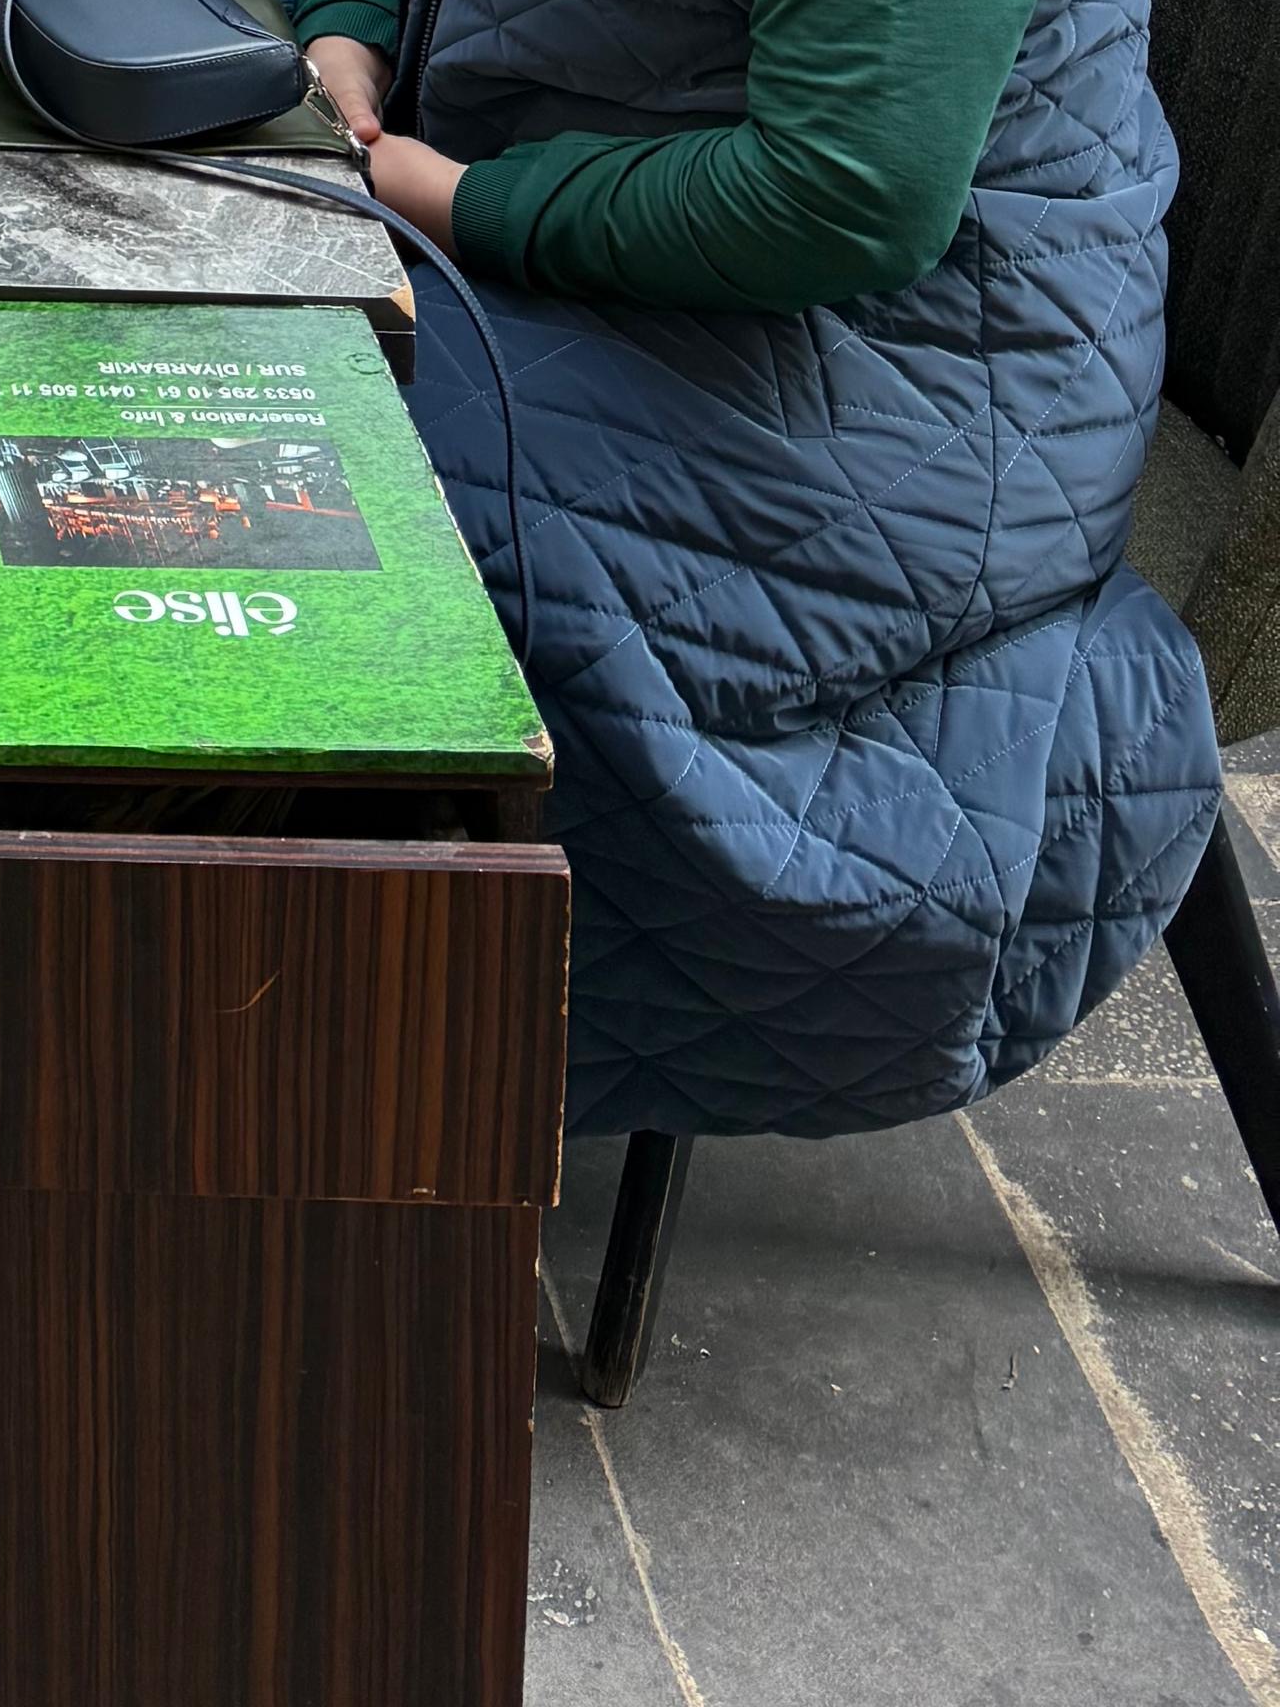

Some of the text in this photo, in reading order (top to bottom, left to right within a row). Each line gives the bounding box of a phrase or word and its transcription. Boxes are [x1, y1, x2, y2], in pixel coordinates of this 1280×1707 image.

[258, 363, 308, 378] SUR
[10, 382, 31, 396] 11
[38, 383, 78, 398] 505
[83, 383, 137, 399] 0412
[155, 385, 181, 399] 61
[188, 385, 213, 399] 10
[219, 386, 259, 400] 295
[263, 386, 317, 401] 0533
[169, 410, 186, 425] &
[191, 408, 326, 427] Reservation
[112, 589, 298, 637] élise
